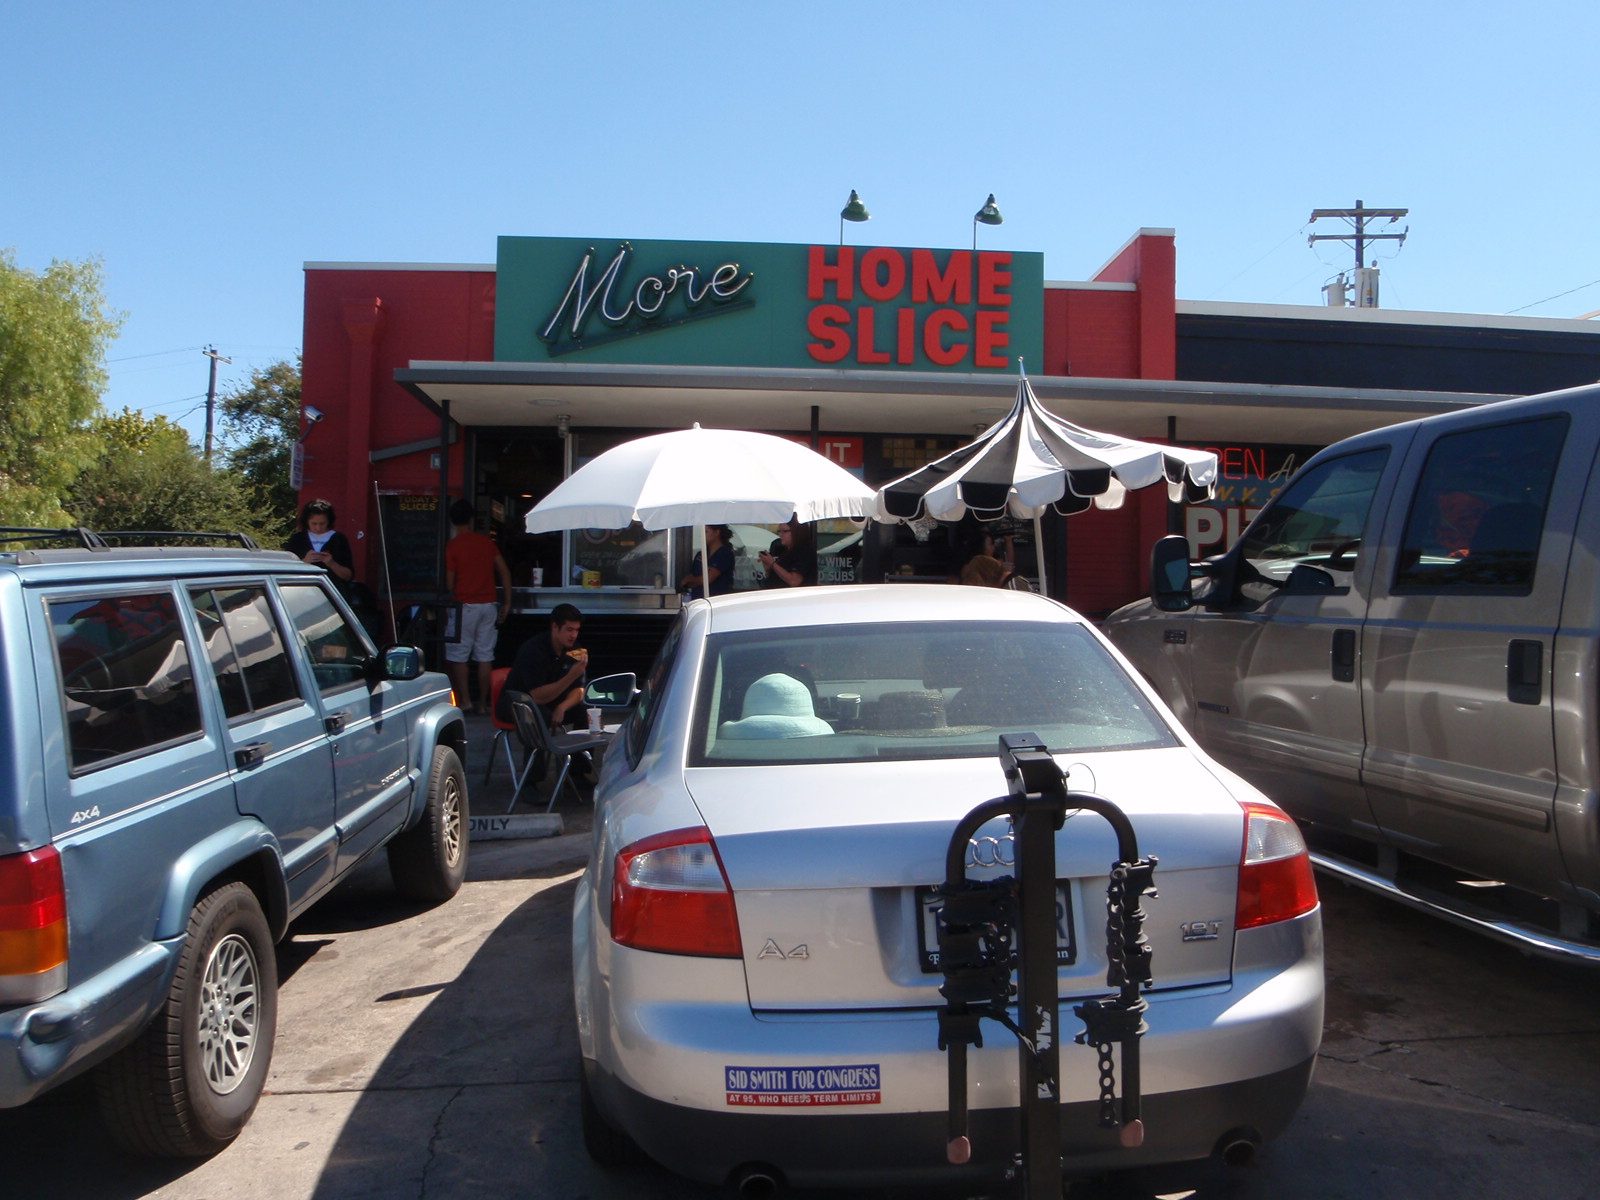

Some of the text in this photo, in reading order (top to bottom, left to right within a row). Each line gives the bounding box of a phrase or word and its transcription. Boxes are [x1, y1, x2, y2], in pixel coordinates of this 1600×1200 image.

[807, 245, 1013, 306] HOME
[540, 245, 753, 340] More
[806, 303, 1010, 368] SLICE
[1202, 447, 1265, 480] PEN
[400, 503, 437, 511] SLICES
[826, 557, 853, 568] WINE
[828, 570, 855, 582] SUBS
[71, 805, 100, 824] 4x4
[757, 938, 810, 960] A4
[728, 1067, 878, 1089] SID SMITH FOR CONGRESS
[729, 1094, 740, 1103] AT
[742, 1094, 756, 1104] 95,
[758, 1094, 779, 1103] WHO
[813, 1093, 839, 1103] TERM
[841, 1092, 876, 1102] LIMITS?
